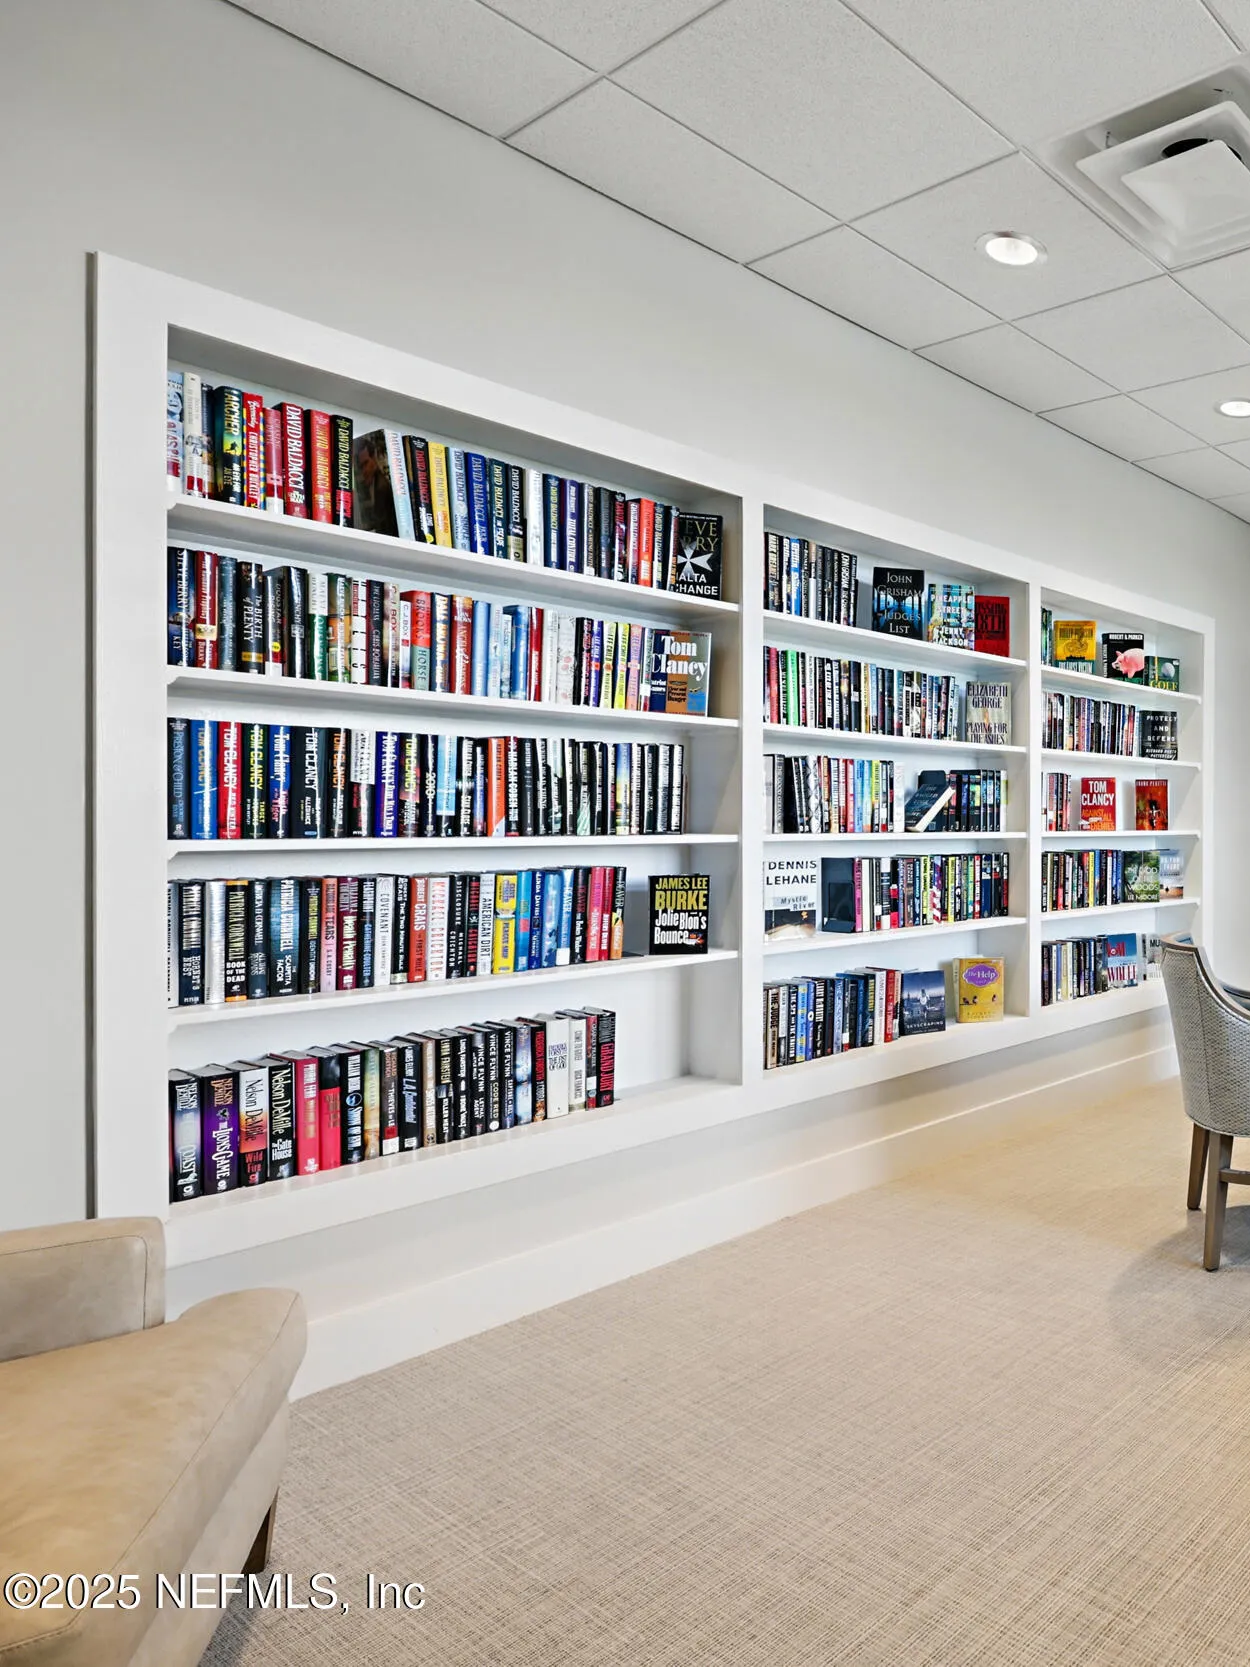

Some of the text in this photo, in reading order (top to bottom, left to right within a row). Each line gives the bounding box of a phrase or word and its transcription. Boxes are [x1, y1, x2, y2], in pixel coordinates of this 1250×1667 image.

[224, 393, 240, 436] ARCHER
[248, 432, 259, 471] CHRISTOPHER
[286, 405, 304, 489] DAVID BALDACCI
[338, 428, 350, 489] DAVID BALDACCI
[415, 450, 428, 504] DAVID BALDACCI
[454, 451, 466, 502] DAVID BALDACCI
[472, 457, 485, 522] DAVID BALDACCI
[494, 465, 504, 518] DAVID BALDACCI
[512, 468, 521, 522] DAVID BALDACCI
[877, 584, 922, 597] GRISHAM
[887, 572, 912, 583] JOHN
[930, 595, 972, 603] PINEAPPLE
[243, 606, 254, 642] PLENTY
[254, 607, 263, 639] BIRTH
[889, 622, 911, 634] LIST
[940, 627, 963, 635] JENNY
[415, 598, 427, 682] BROOKS HORSE
[661, 635, 697, 657] Tom
[652, 654, 709, 682] Clancy
[967, 684, 1008, 697] ELIZABETH
[1150, 680, 1178, 691] GOLF
[972, 697, 1002, 709] GEORGE
[274, 734, 290, 751] Tom
[224, 728, 237, 790] TOM CLANCY
[250, 728, 263, 790] TOM CLANCY
[305, 732, 318, 790] TOM CLANCY
[333, 732, 347, 790] TOM CLANCY
[405, 737, 417, 794] TOM CLANCY
[173, 772, 184, 798] CHILD
[426, 772, 436, 796] 2010
[508, 752, 518, 808] HARLAN COBEN
[1089, 781, 1107, 794] TOM
[271, 799, 280, 822] Tiger
[1082, 793, 1115, 806] CLANCY
[1082, 808, 1105, 817] AGAINST
[1090, 821, 1115, 831] ENEMIES
[769, 860, 817, 870] DENNIS
[416, 879, 425, 902] ROBERT
[655, 877, 708, 890] JAMES LEE
[766, 875, 817, 886] LEHANE
[1127, 883, 1159, 891] WOODS
[534, 895, 542, 916] DAVIES
[564, 887, 573, 913] DEAVER
[615, 881, 624, 908] DEAVER
[655, 889, 708, 911] BURKE
[780, 895, 808, 905] Mystic
[793, 901, 815, 911] River
[183, 885, 202, 951] PATRICIA CORNWELL
[229, 892, 245, 961] PATRICIA CORNWELL
[280, 880, 294, 952] PATRICIA CORNWELL
[379, 894, 390, 934] COVENANT
[414, 903, 426, 931] CRAIS
[468, 881, 479, 963] MICHAEL CRICHTON
[655, 909, 680, 927] Jolie
[254, 915, 263, 946] CORNWELL
[326, 915, 335, 940] TEARS
[363, 882, 374, 977] FLASHPOINT COULTER
[430, 882, 445, 973] MICHAEL CRICHTON
[481, 898, 493, 957] AMERICAN DIRT
[654, 926, 690, 945] Bounce
[340, 941, 357, 971] Penalty
[575, 936, 583, 953] Window
[183, 957, 192, 977] NEST
[276, 960, 284, 982] FACTOR
[977, 970, 995, 979] Help
[770, 992, 779, 1029] THE JUDGE
[906, 1020, 944, 1030] SKYSCRAPING
[458, 1039, 466, 1054] LINDA
[489, 1033, 497, 1056] VINCE
[536, 1031, 545, 1057] FREDERICK
[440, 1039, 452, 1084] LINDA FAIRSTEIN
[489, 1057, 497, 1081] FLYNN
[600, 1043, 614, 1092] GRAND JURY
[189, 1083, 198, 1108] NELSON
[223, 1078, 233, 1105] NELSON
[272, 1068, 292, 1135] Nelson DeMille
[388, 1088, 396, 1114] THIEVES
[245, 1079, 264, 1142] Nelson DeMille
[403, 1091, 417, 1124] Confidential
[211, 1151, 234, 1179] GAME
[245, 1152, 263, 1163] Wild
